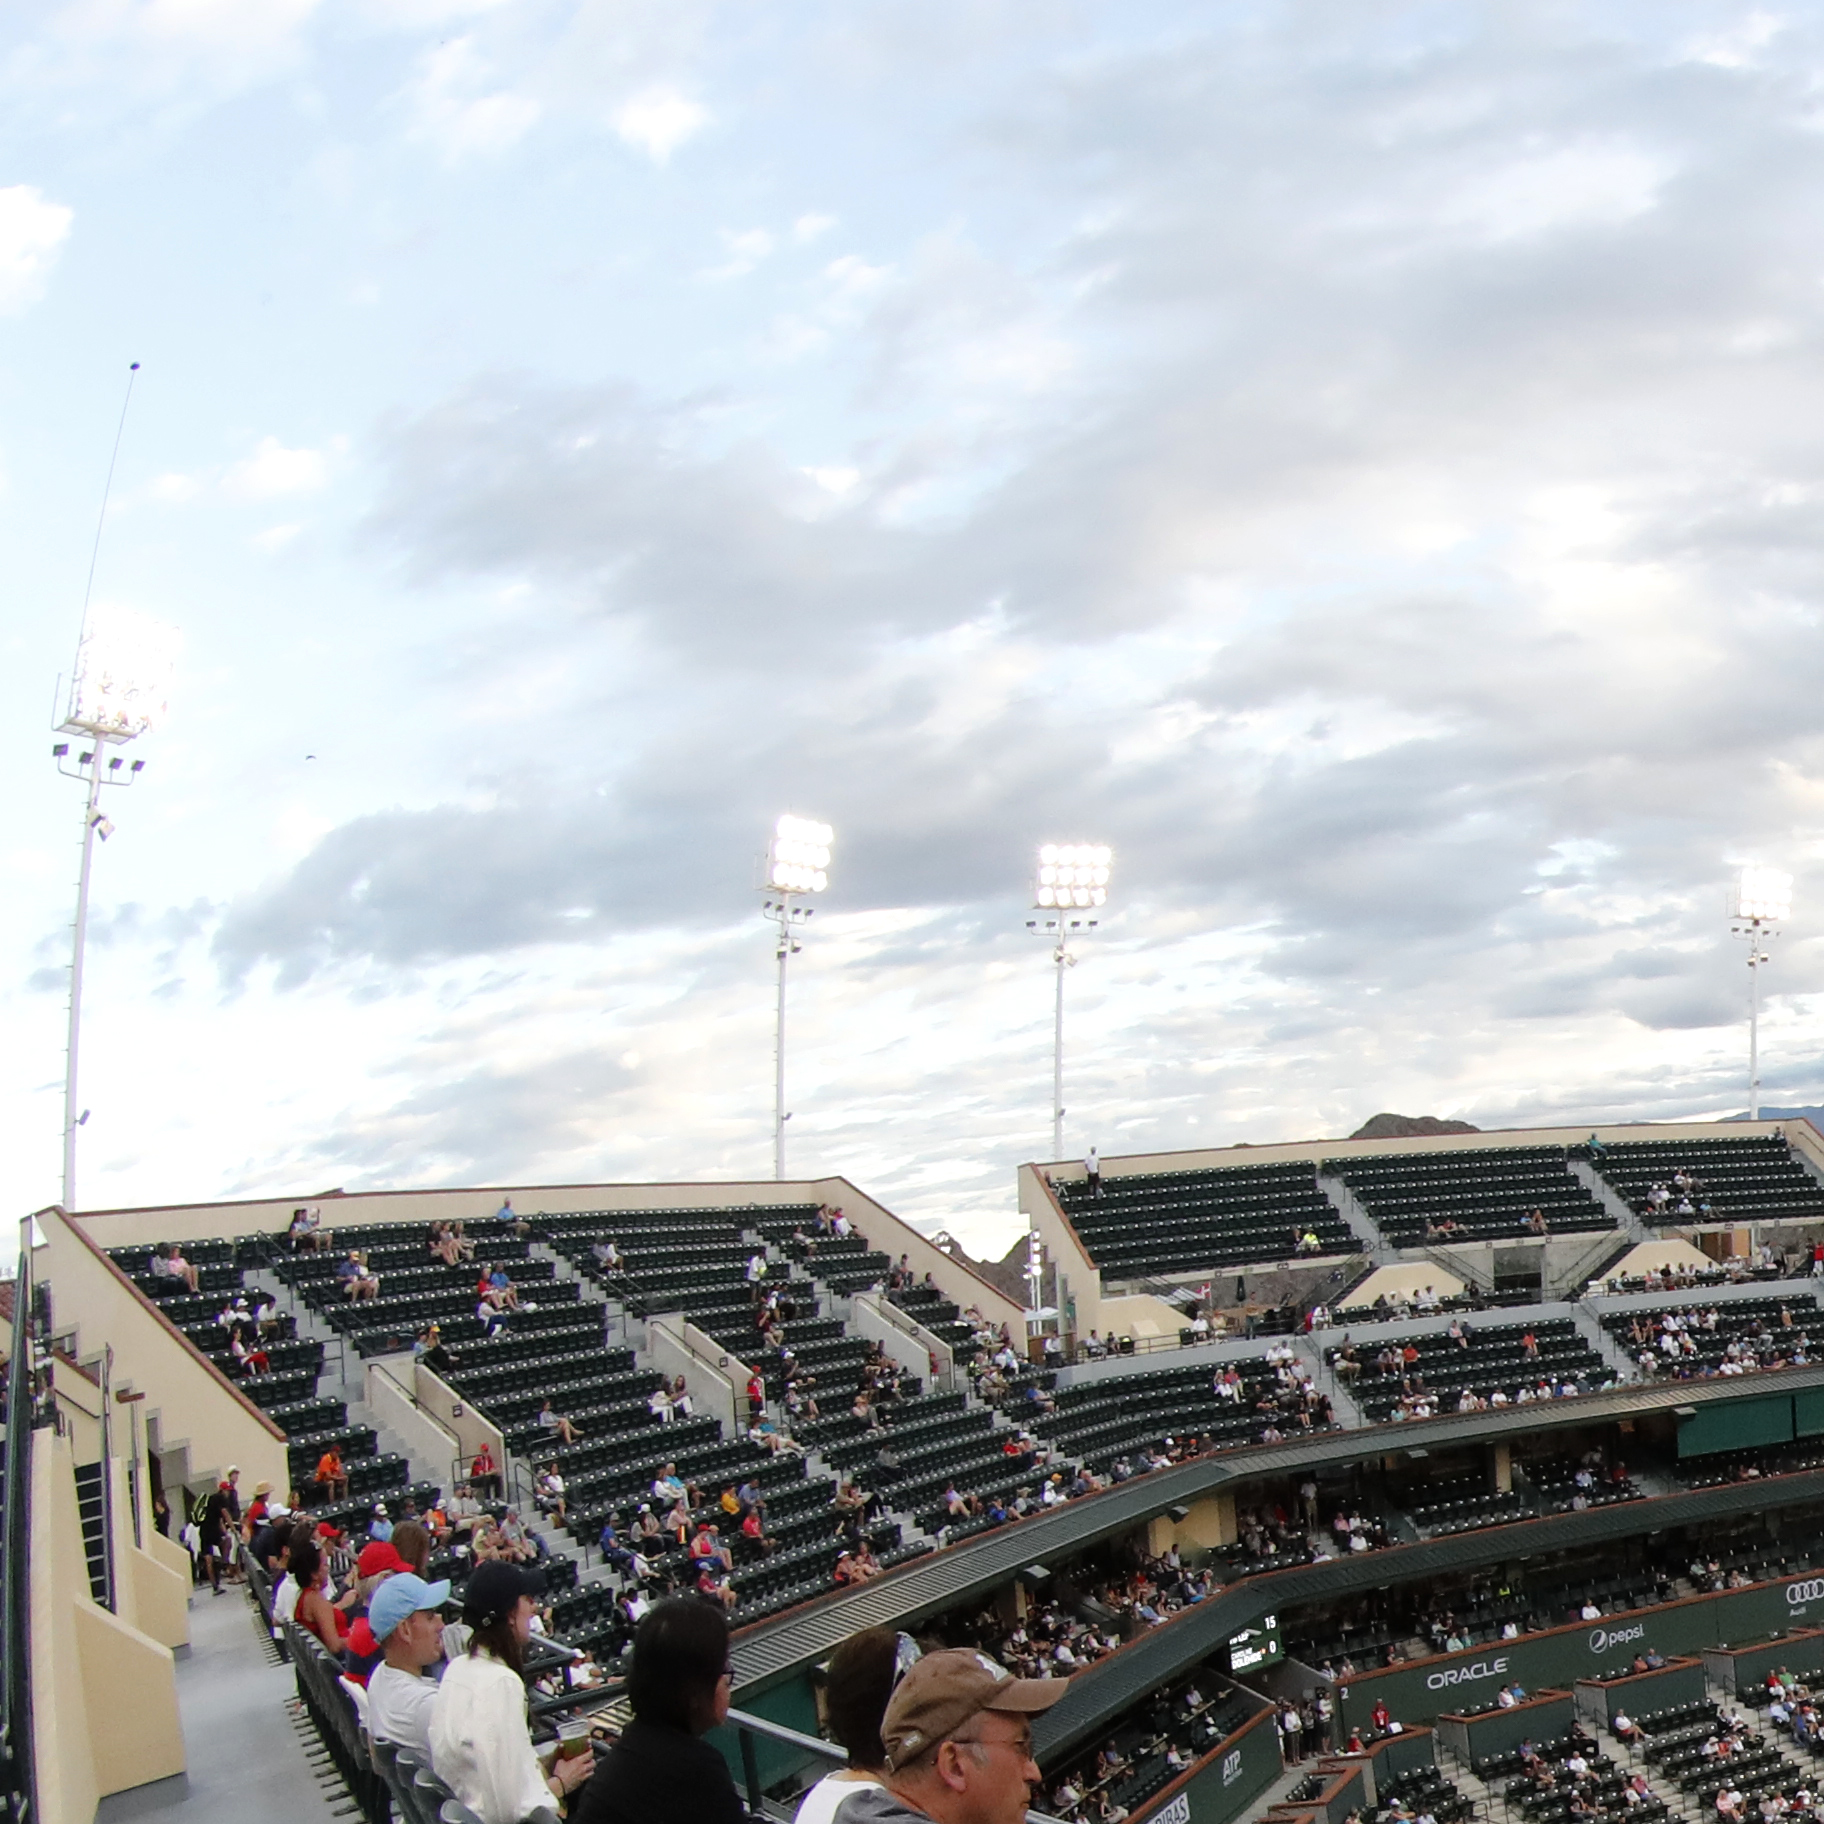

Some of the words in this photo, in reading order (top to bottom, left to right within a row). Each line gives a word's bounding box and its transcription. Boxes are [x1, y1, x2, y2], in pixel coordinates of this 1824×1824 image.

[1264, 1615, 1276, 1630] 15
[1608, 1623, 1645, 1648] pepsi
[1269, 1640, 1277, 1654] 0
[1426, 1657, 1508, 1690] ORACLE
[1340, 1686, 1349, 1700] 2
[1223, 1750, 1241, 1780] ATP
